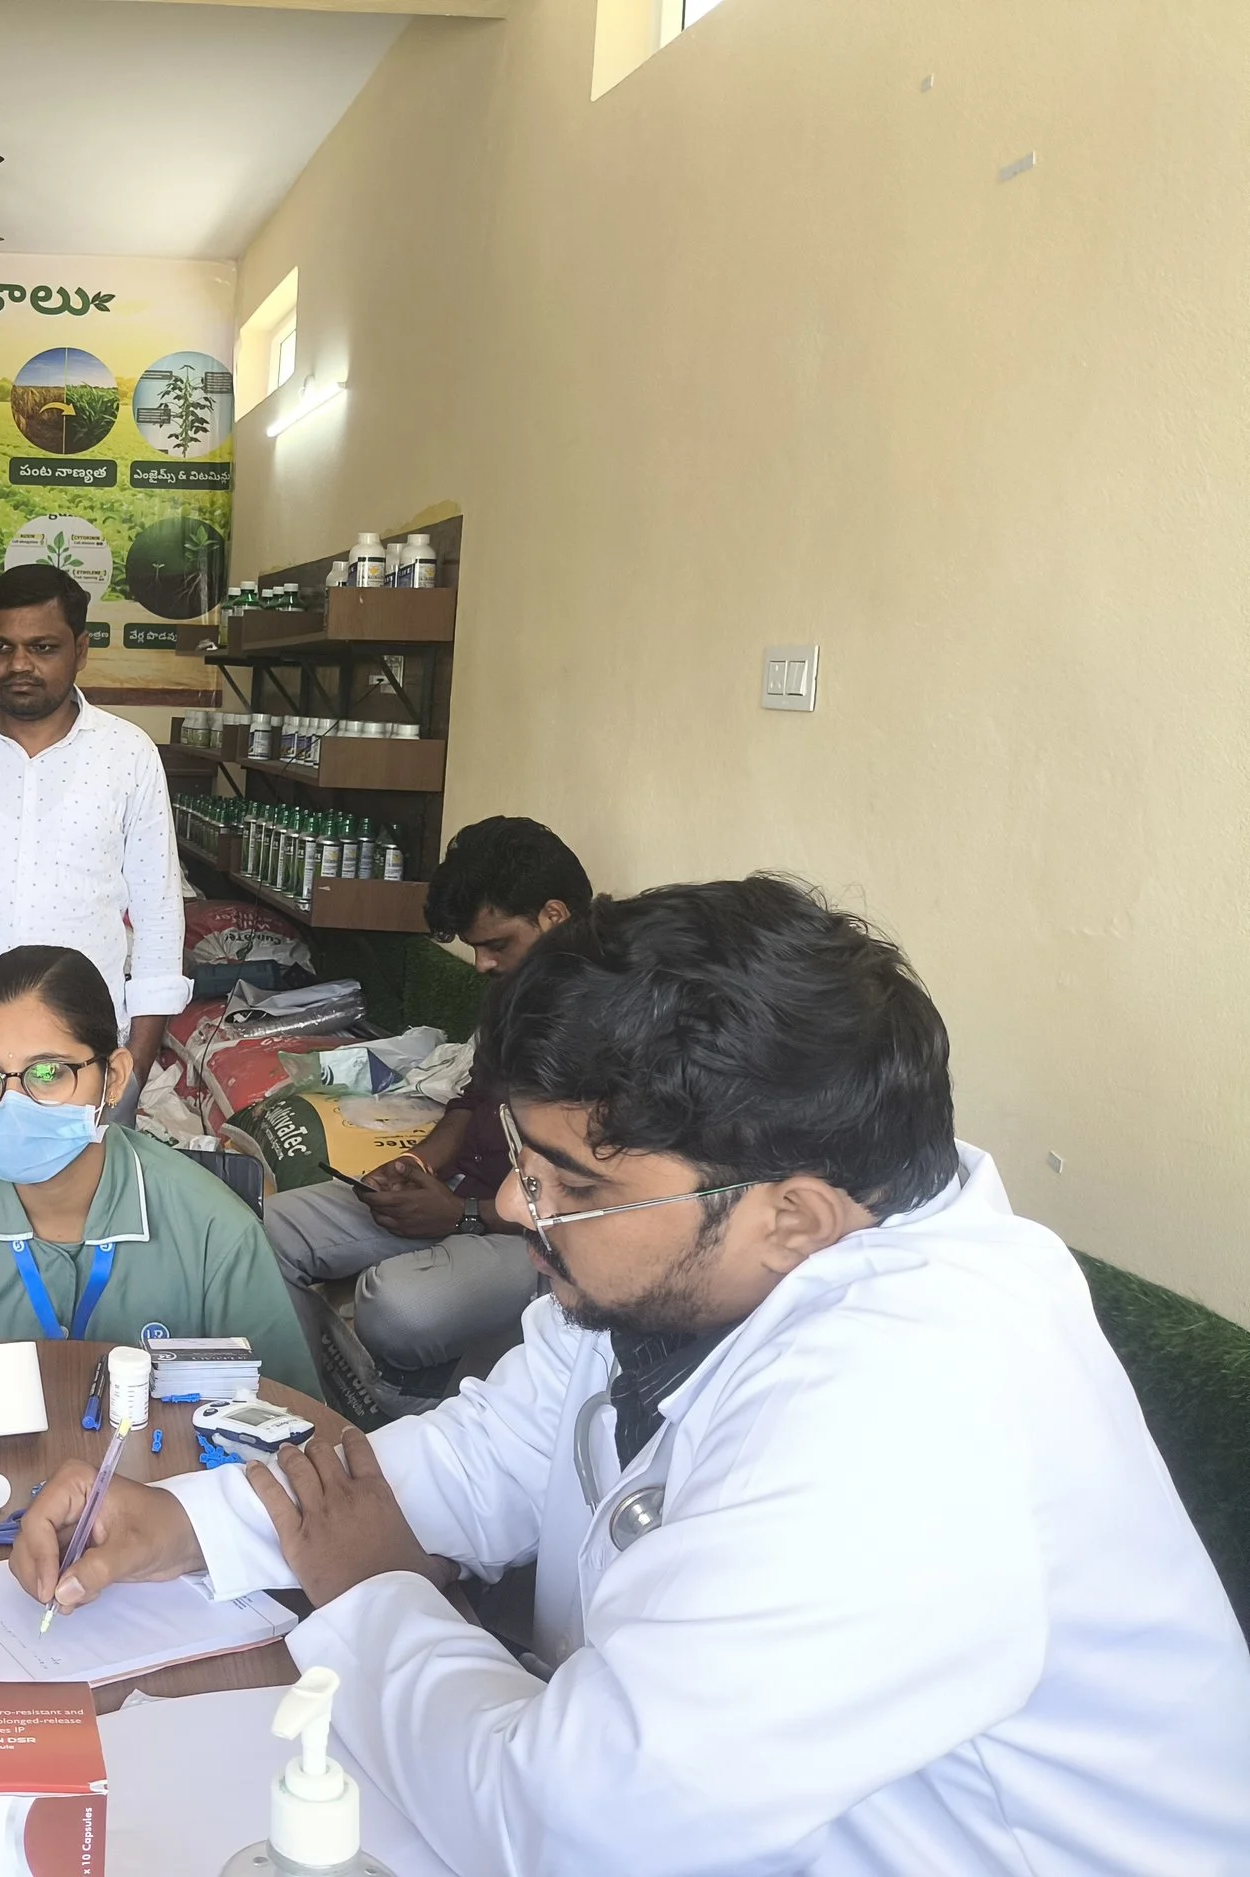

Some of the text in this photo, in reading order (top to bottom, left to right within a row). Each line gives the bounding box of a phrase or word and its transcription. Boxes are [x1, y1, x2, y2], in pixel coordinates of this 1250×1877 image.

[19, 465, 107, 483] పంట నాణ్యత
[178, 472, 187, 480] &
[64, 1708, 84, 1716] and
[14, 1726, 25, 1734] IP
[82, 1807, 94, 1851] Capsules
[82, 1853, 91, 1866] 10
